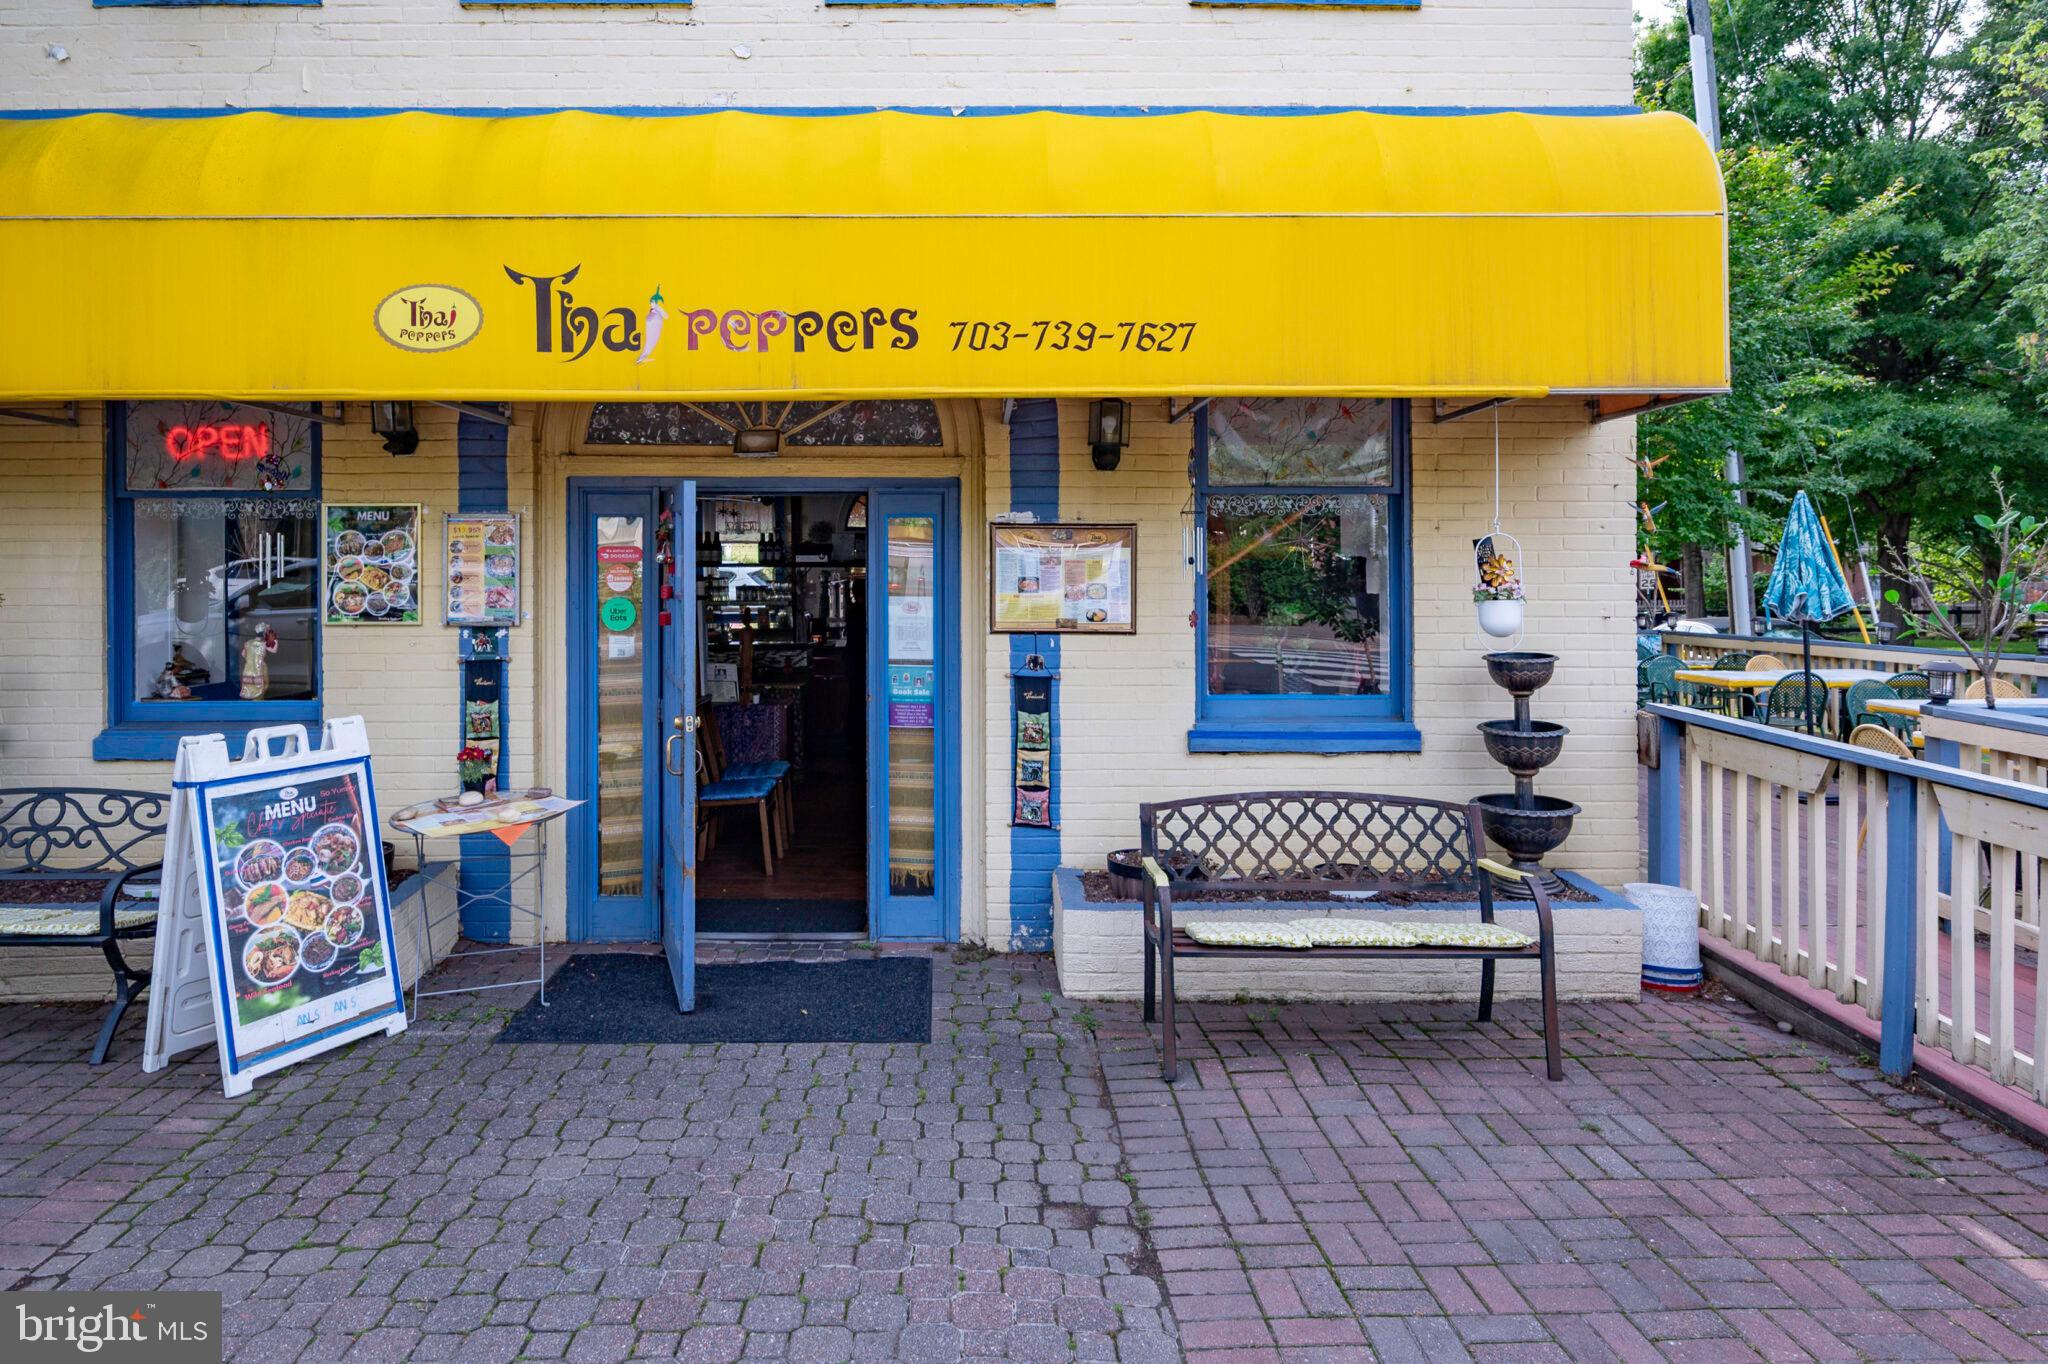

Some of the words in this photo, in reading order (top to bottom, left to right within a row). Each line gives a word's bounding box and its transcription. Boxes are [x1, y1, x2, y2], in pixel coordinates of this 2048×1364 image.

[400, 297, 457, 330] Thai
[503, 263, 669, 365] Thai
[949, 320, 1198, 353] 703-739-7627
[165, 425, 269, 461] OPEN
[356, 511, 390, 521] MENU
[610, 607, 627, 615] Uber
[913, 688, 931, 697] Sale
[265, 796, 317, 821] MENU
[264, 980, 293, 994] Seafood
